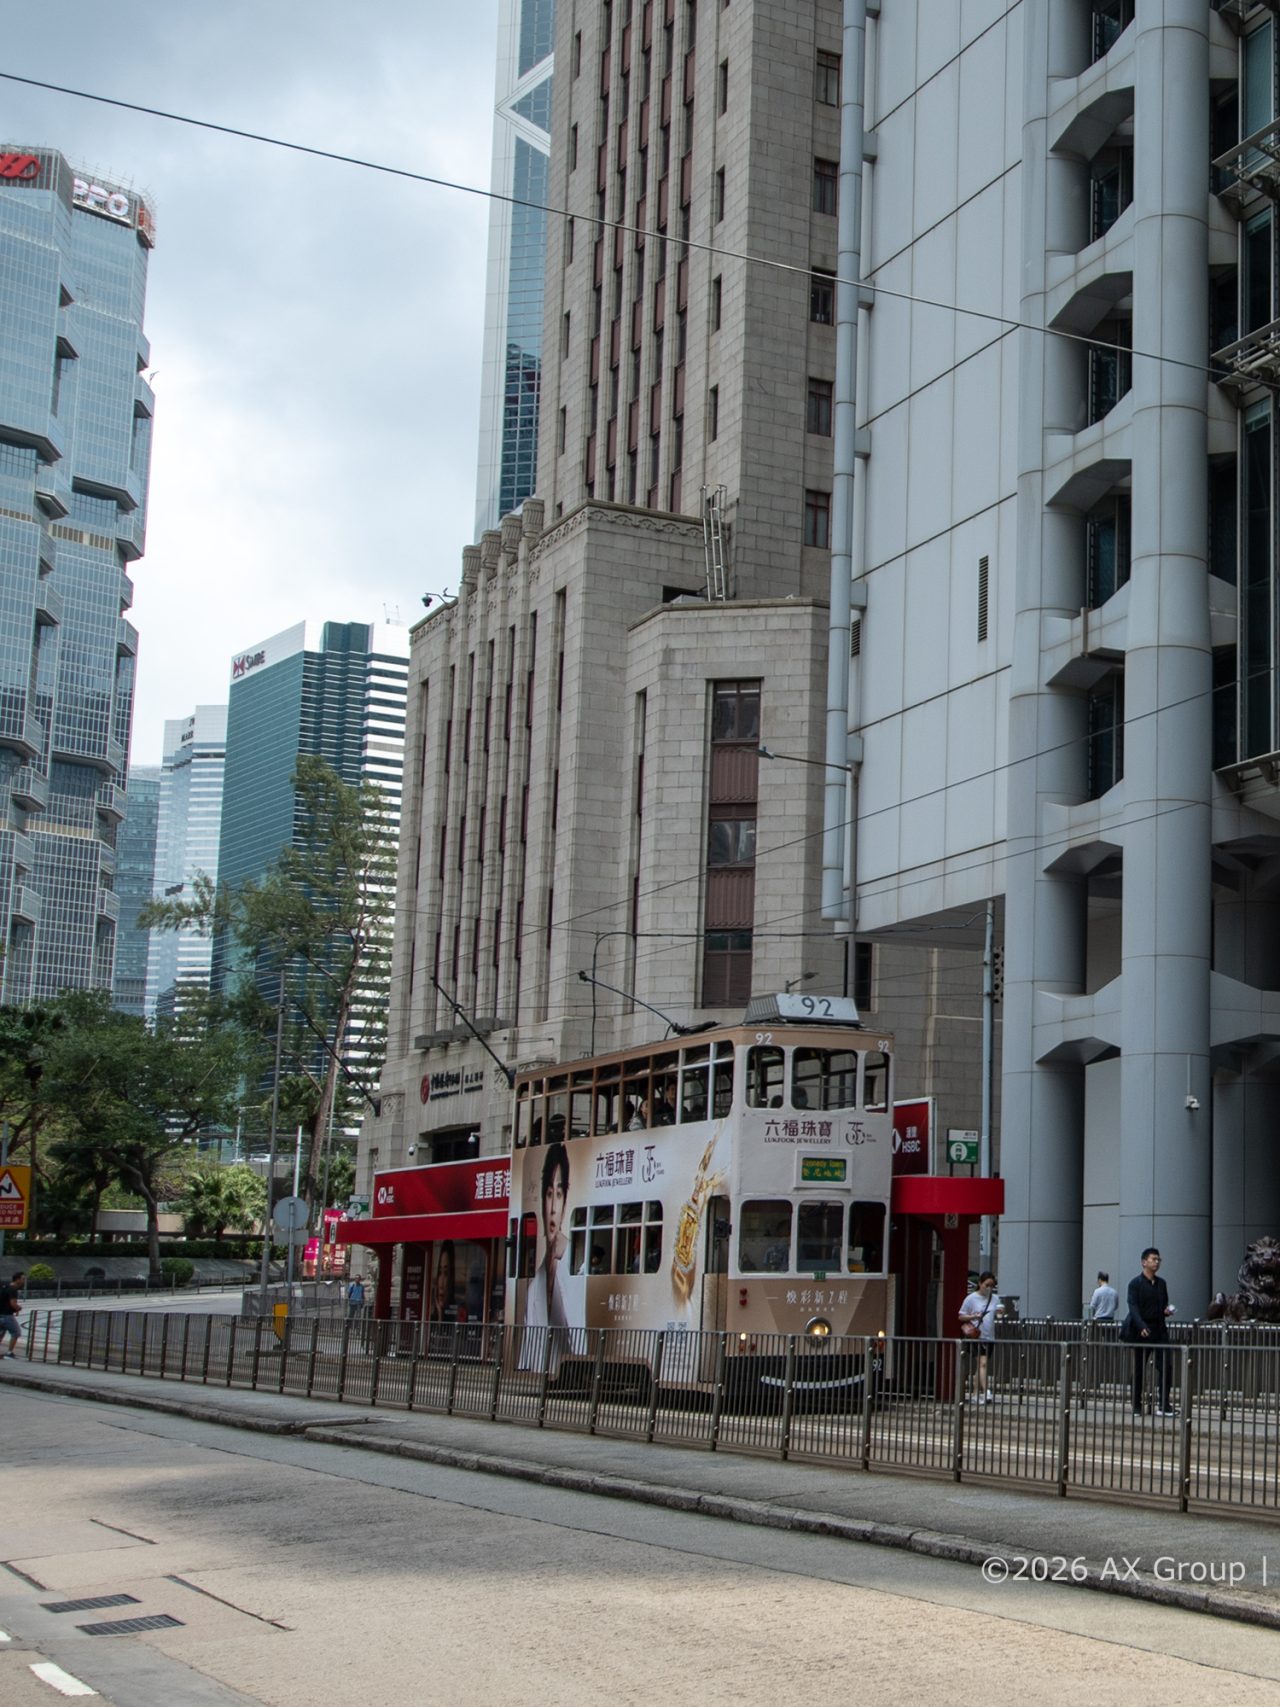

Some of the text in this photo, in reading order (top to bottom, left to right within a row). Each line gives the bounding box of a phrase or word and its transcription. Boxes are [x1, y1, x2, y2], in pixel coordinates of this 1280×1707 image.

[801, 997, 834, 1017] 92
[755, 1033, 772, 1045] 92
[878, 1040, 889, 1052] 92
[765, 1119, 832, 1137] 六福珠寶
[902, 1140, 920, 1153] HSBC
[596, 1149, 634, 1178] 六福珠寶
